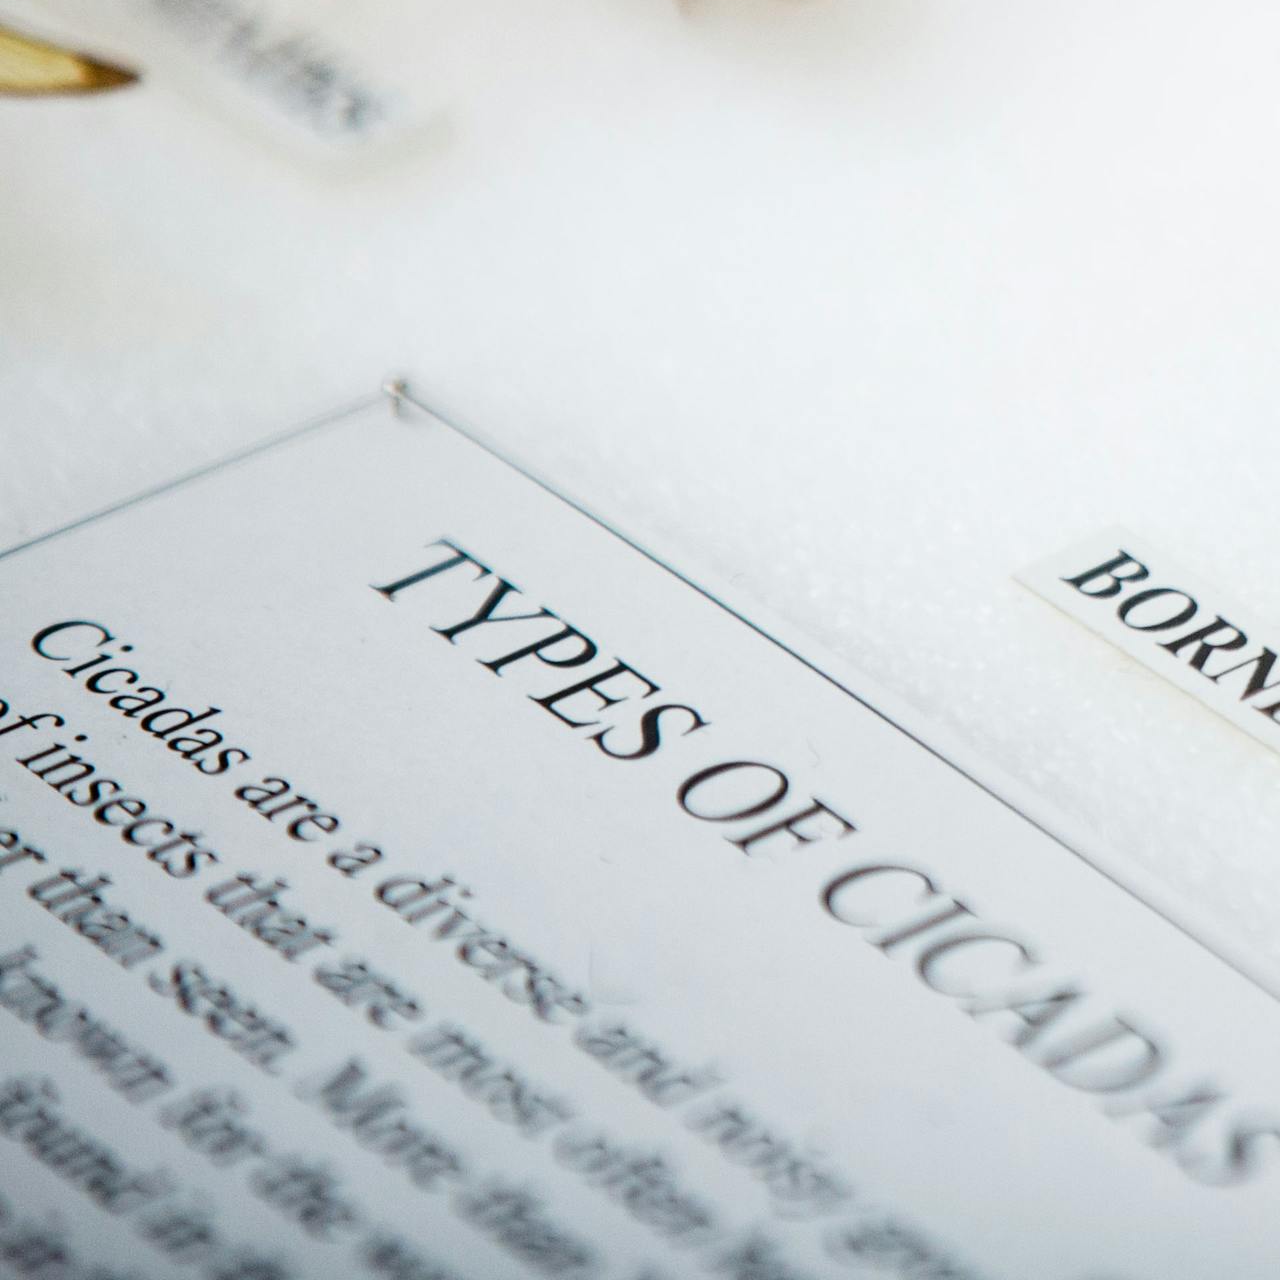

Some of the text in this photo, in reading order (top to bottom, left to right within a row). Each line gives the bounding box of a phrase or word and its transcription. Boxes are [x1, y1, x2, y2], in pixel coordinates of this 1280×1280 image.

[0, 699, 65, 736] f
[369, 537, 711, 762] TYPES
[676, 760, 857, 857] OF
[15, 733, 219, 879] insects
[30, 620, 251, 776] Cicadas
[234, 776, 340, 842] are
[326, 842, 383, 879] a
[373, 874, 591, 1022] diverse
[26, 869, 163, 969] than
[204, 872, 336, 964] that
